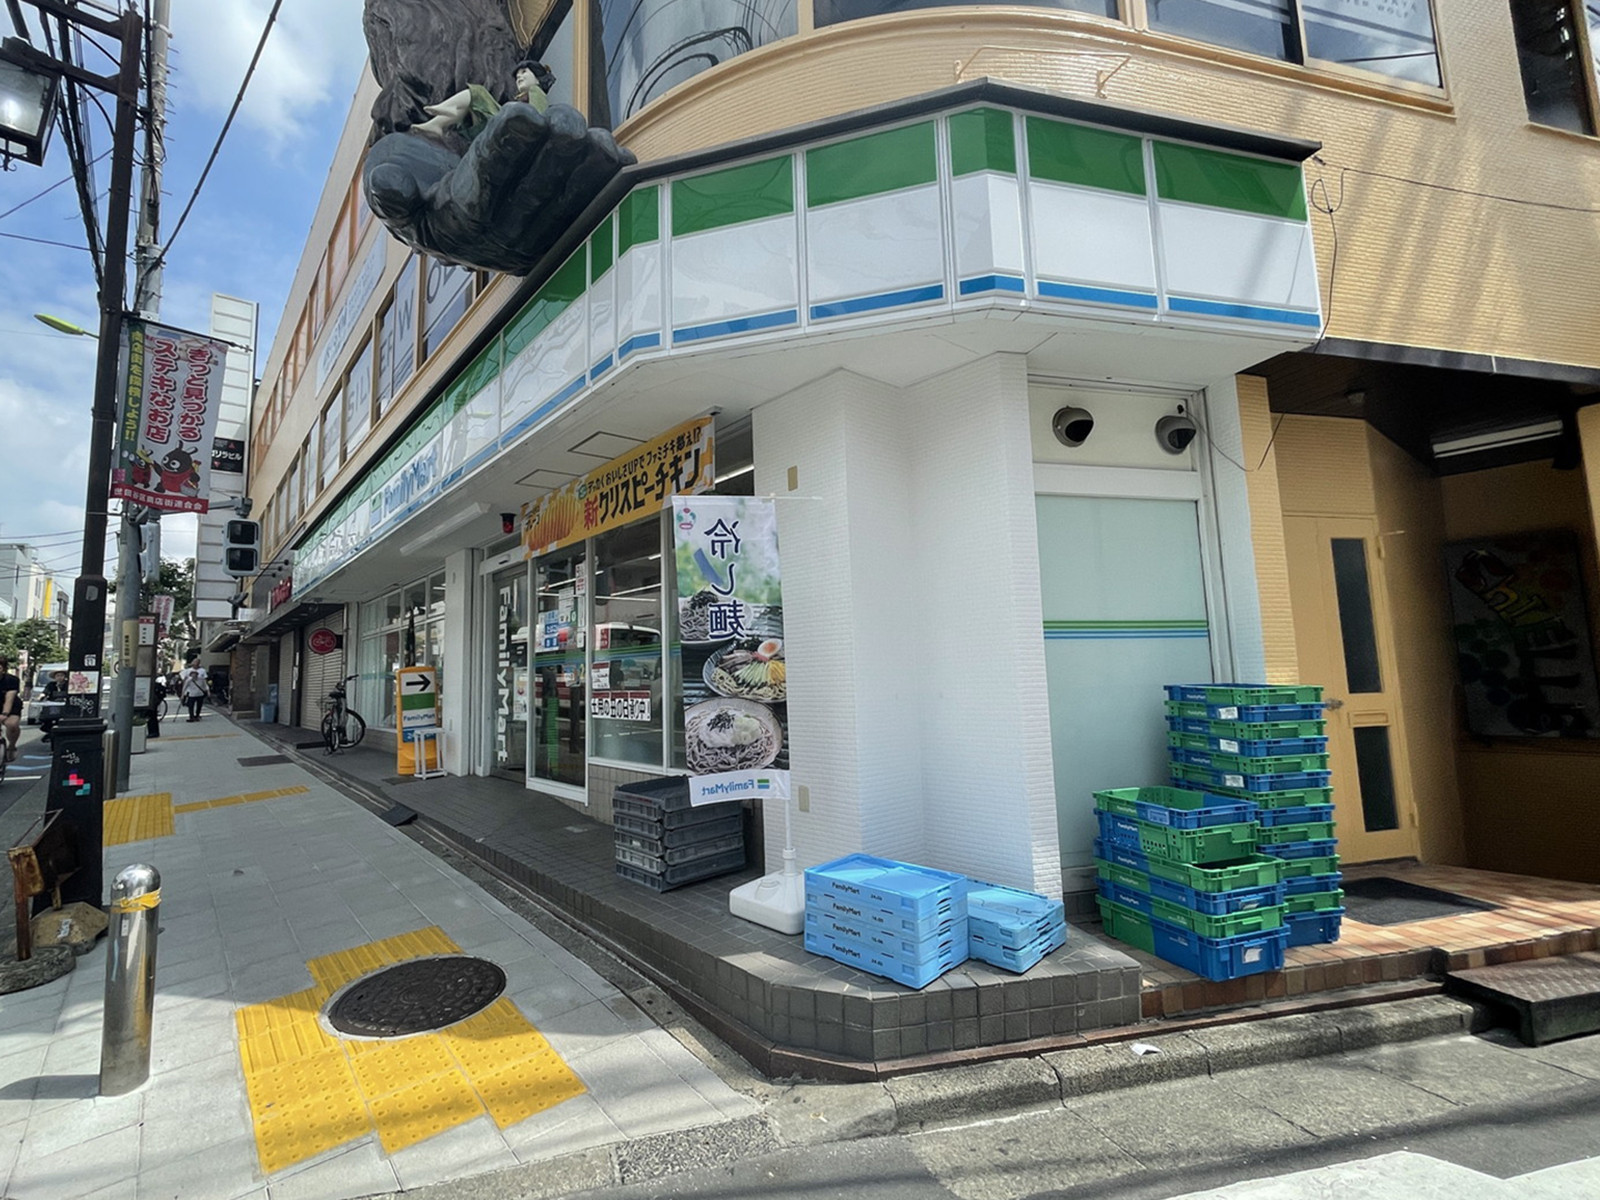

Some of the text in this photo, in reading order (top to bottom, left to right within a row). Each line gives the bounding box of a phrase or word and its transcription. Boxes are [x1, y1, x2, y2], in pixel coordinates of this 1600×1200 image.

[145, 339, 178, 443] ステキなお店
[179, 348, 212, 441] きっと見つかる
[584, 448, 701, 530] 新クリスピーチキン
[496, 586, 511, 762] FamilyMart
[832, 882, 860, 894] FamilyMart
[833, 903, 861, 916] FamilyMart
[832, 923, 861, 937] FamilyMart
[832, 943, 861, 958] FamilyMart
